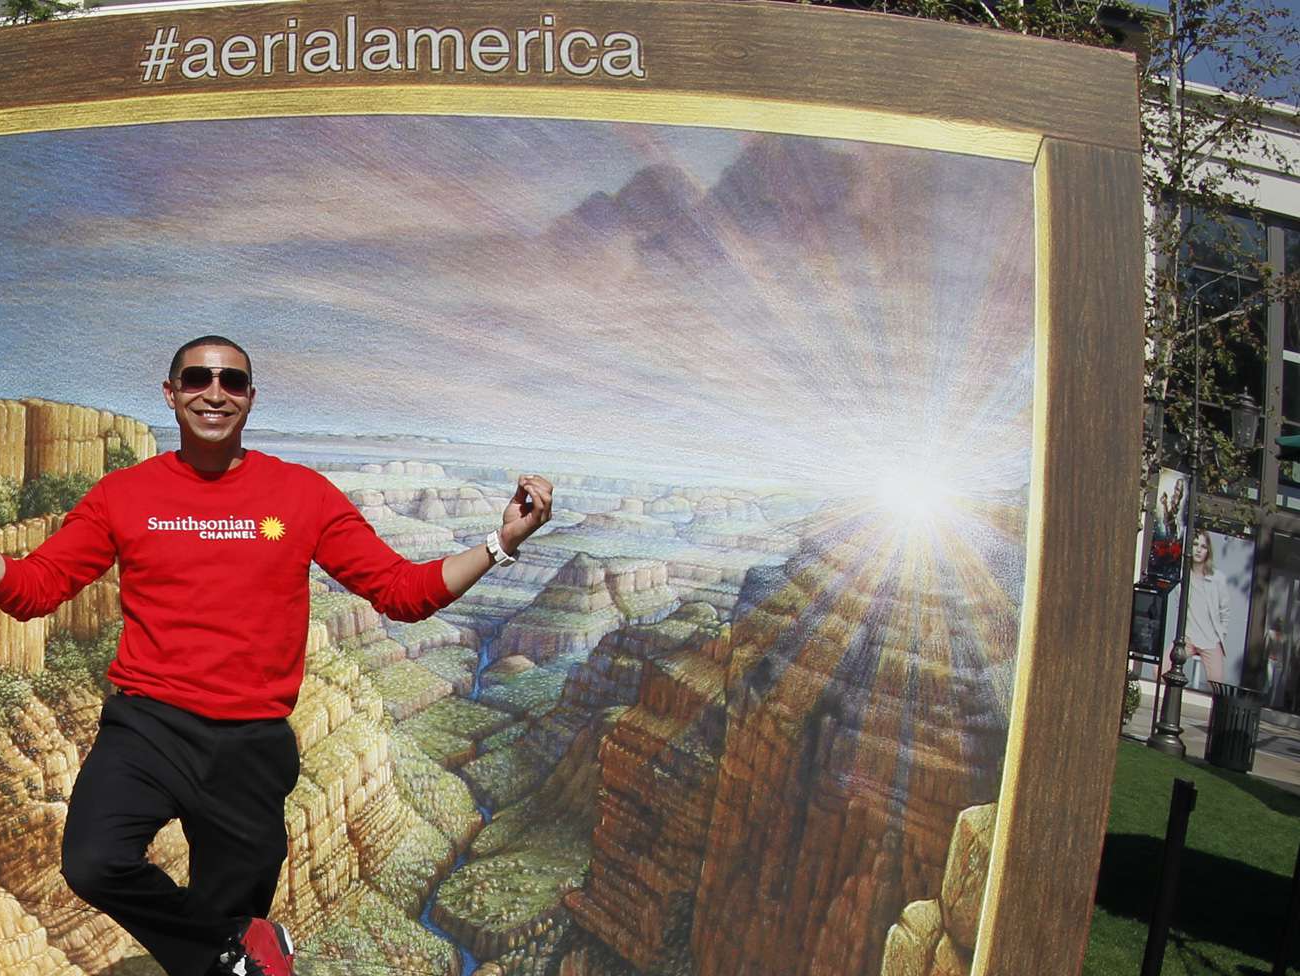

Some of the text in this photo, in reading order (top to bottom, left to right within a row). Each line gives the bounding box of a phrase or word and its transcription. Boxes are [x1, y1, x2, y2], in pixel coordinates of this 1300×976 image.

[140, 16, 644, 82] #aerialamerica
[147, 515, 256, 531] Smithsonian
[199, 531, 257, 540] CHANNEL
